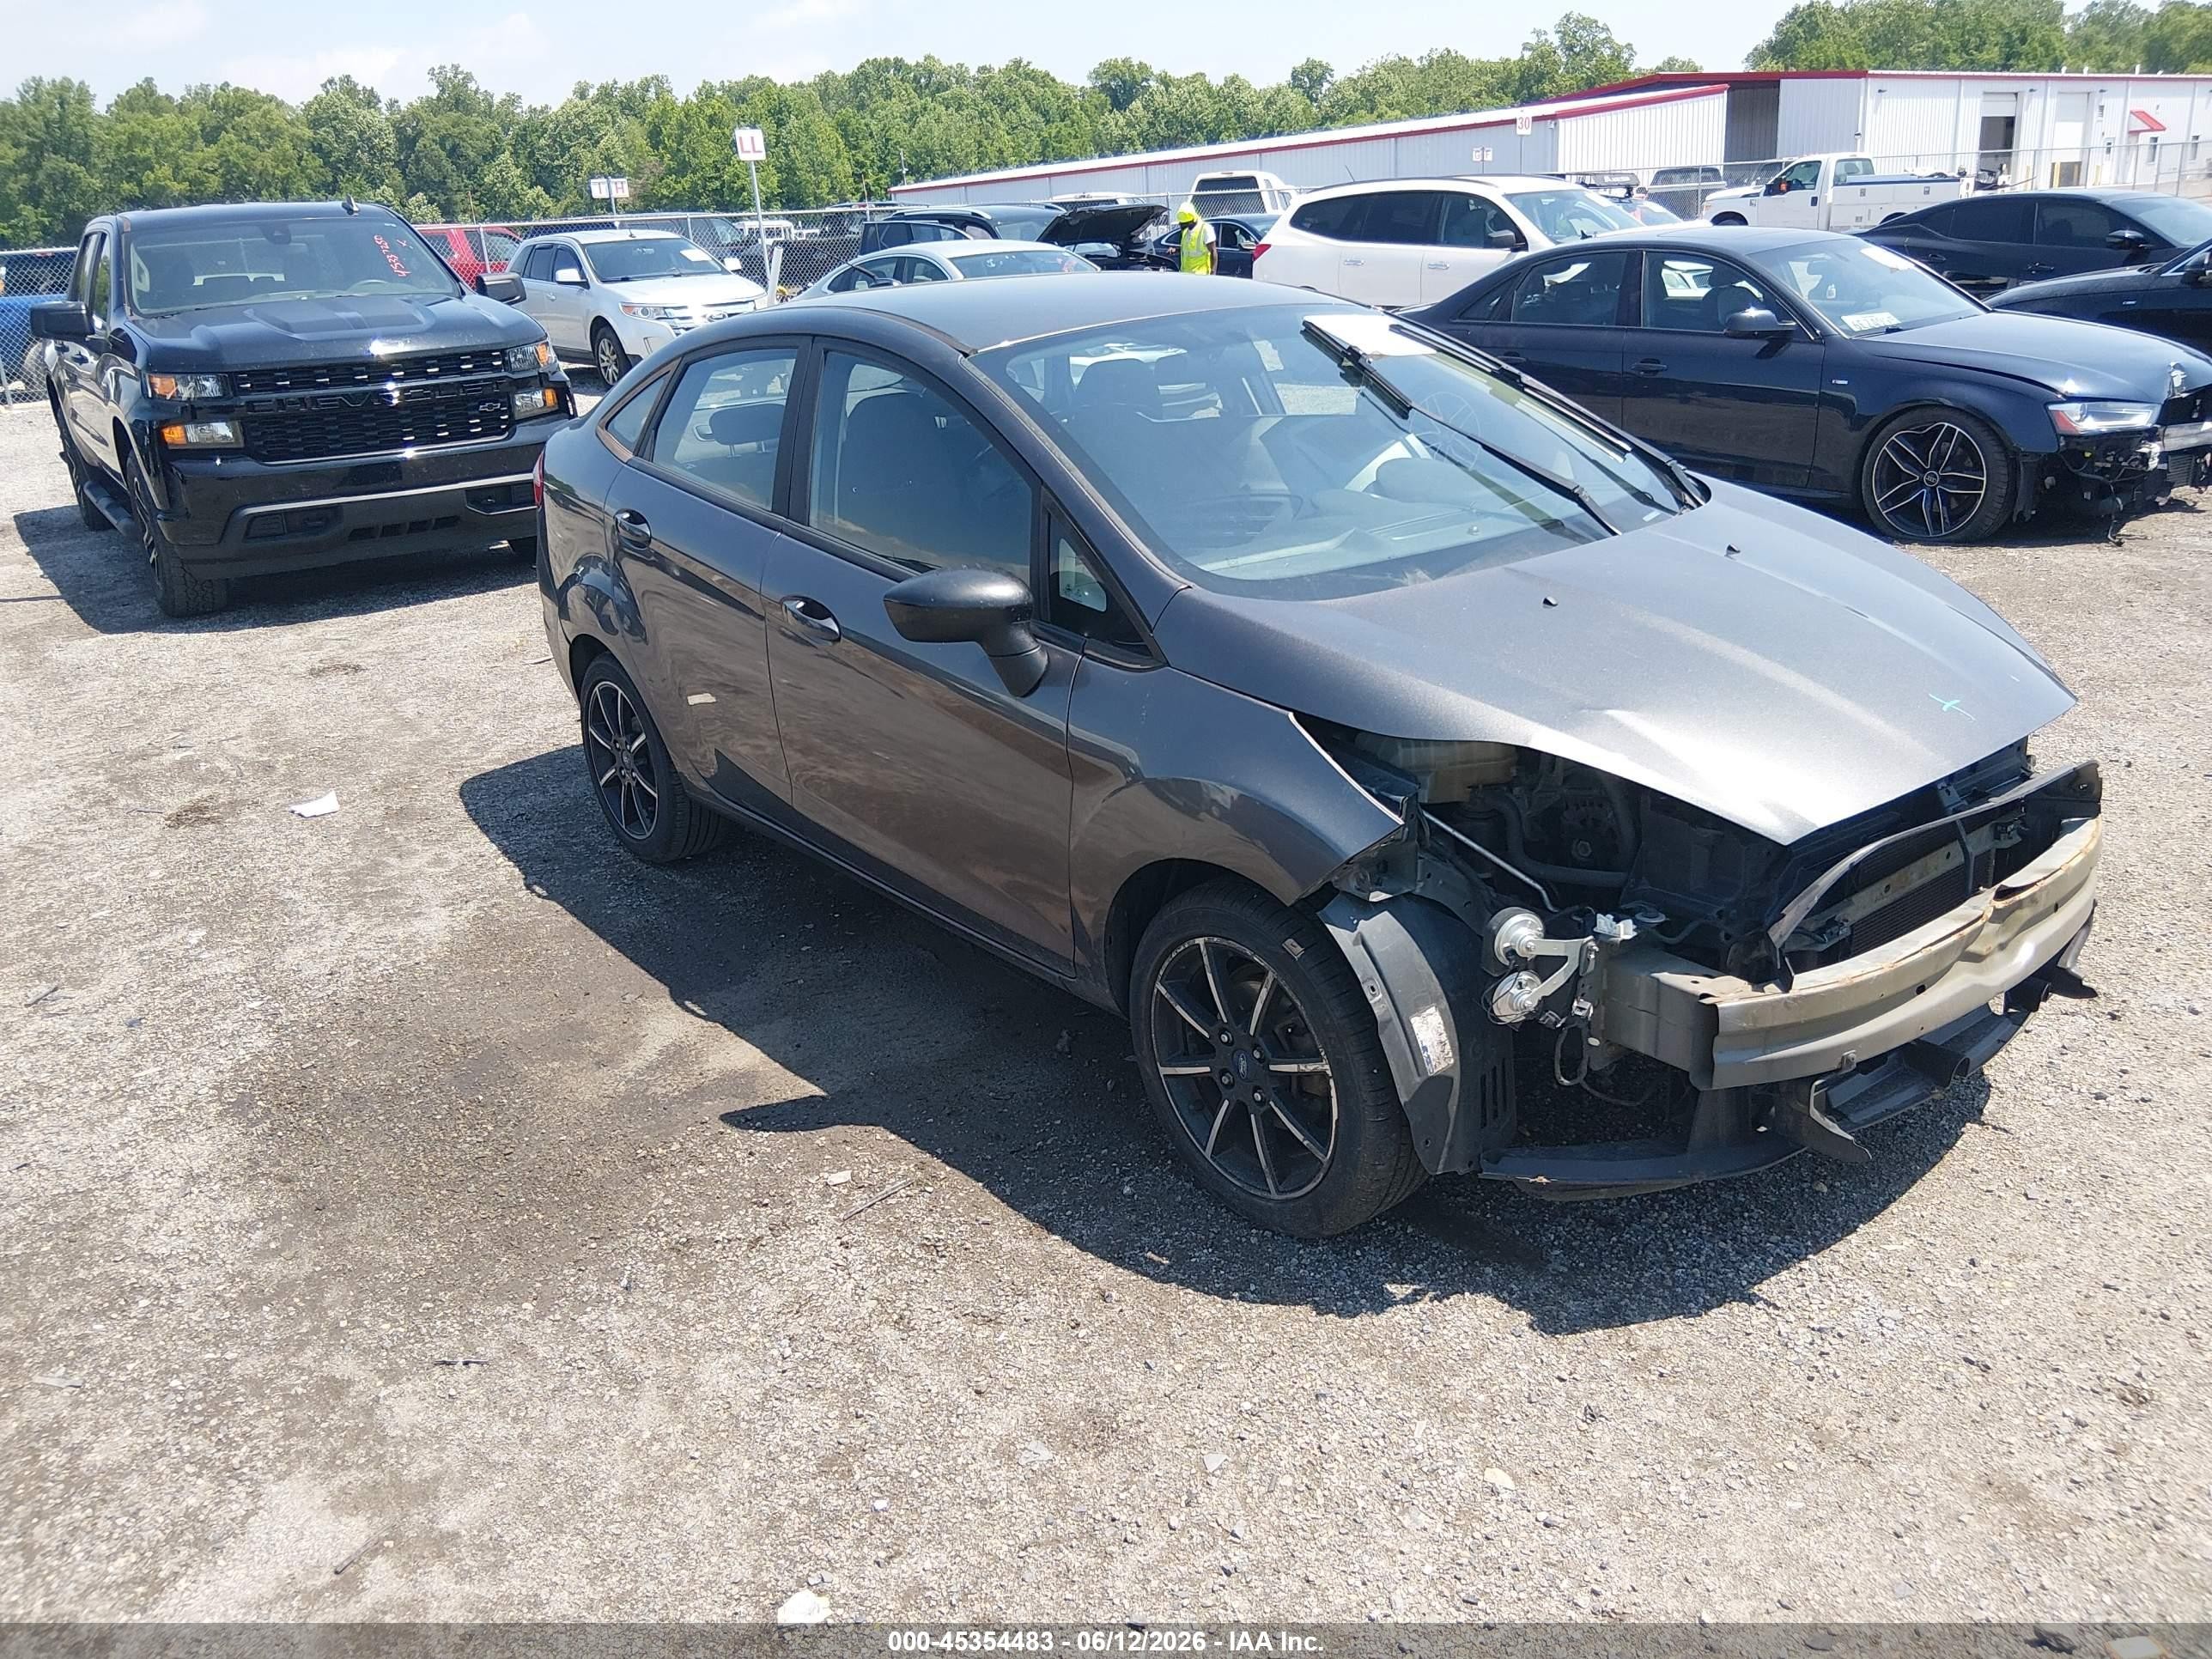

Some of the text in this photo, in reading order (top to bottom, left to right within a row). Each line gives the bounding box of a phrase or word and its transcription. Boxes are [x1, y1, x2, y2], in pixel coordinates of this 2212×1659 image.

[1517, 117, 1530, 130] 30
[738, 136, 763, 154] LL
[615, 181, 625, 194] H
